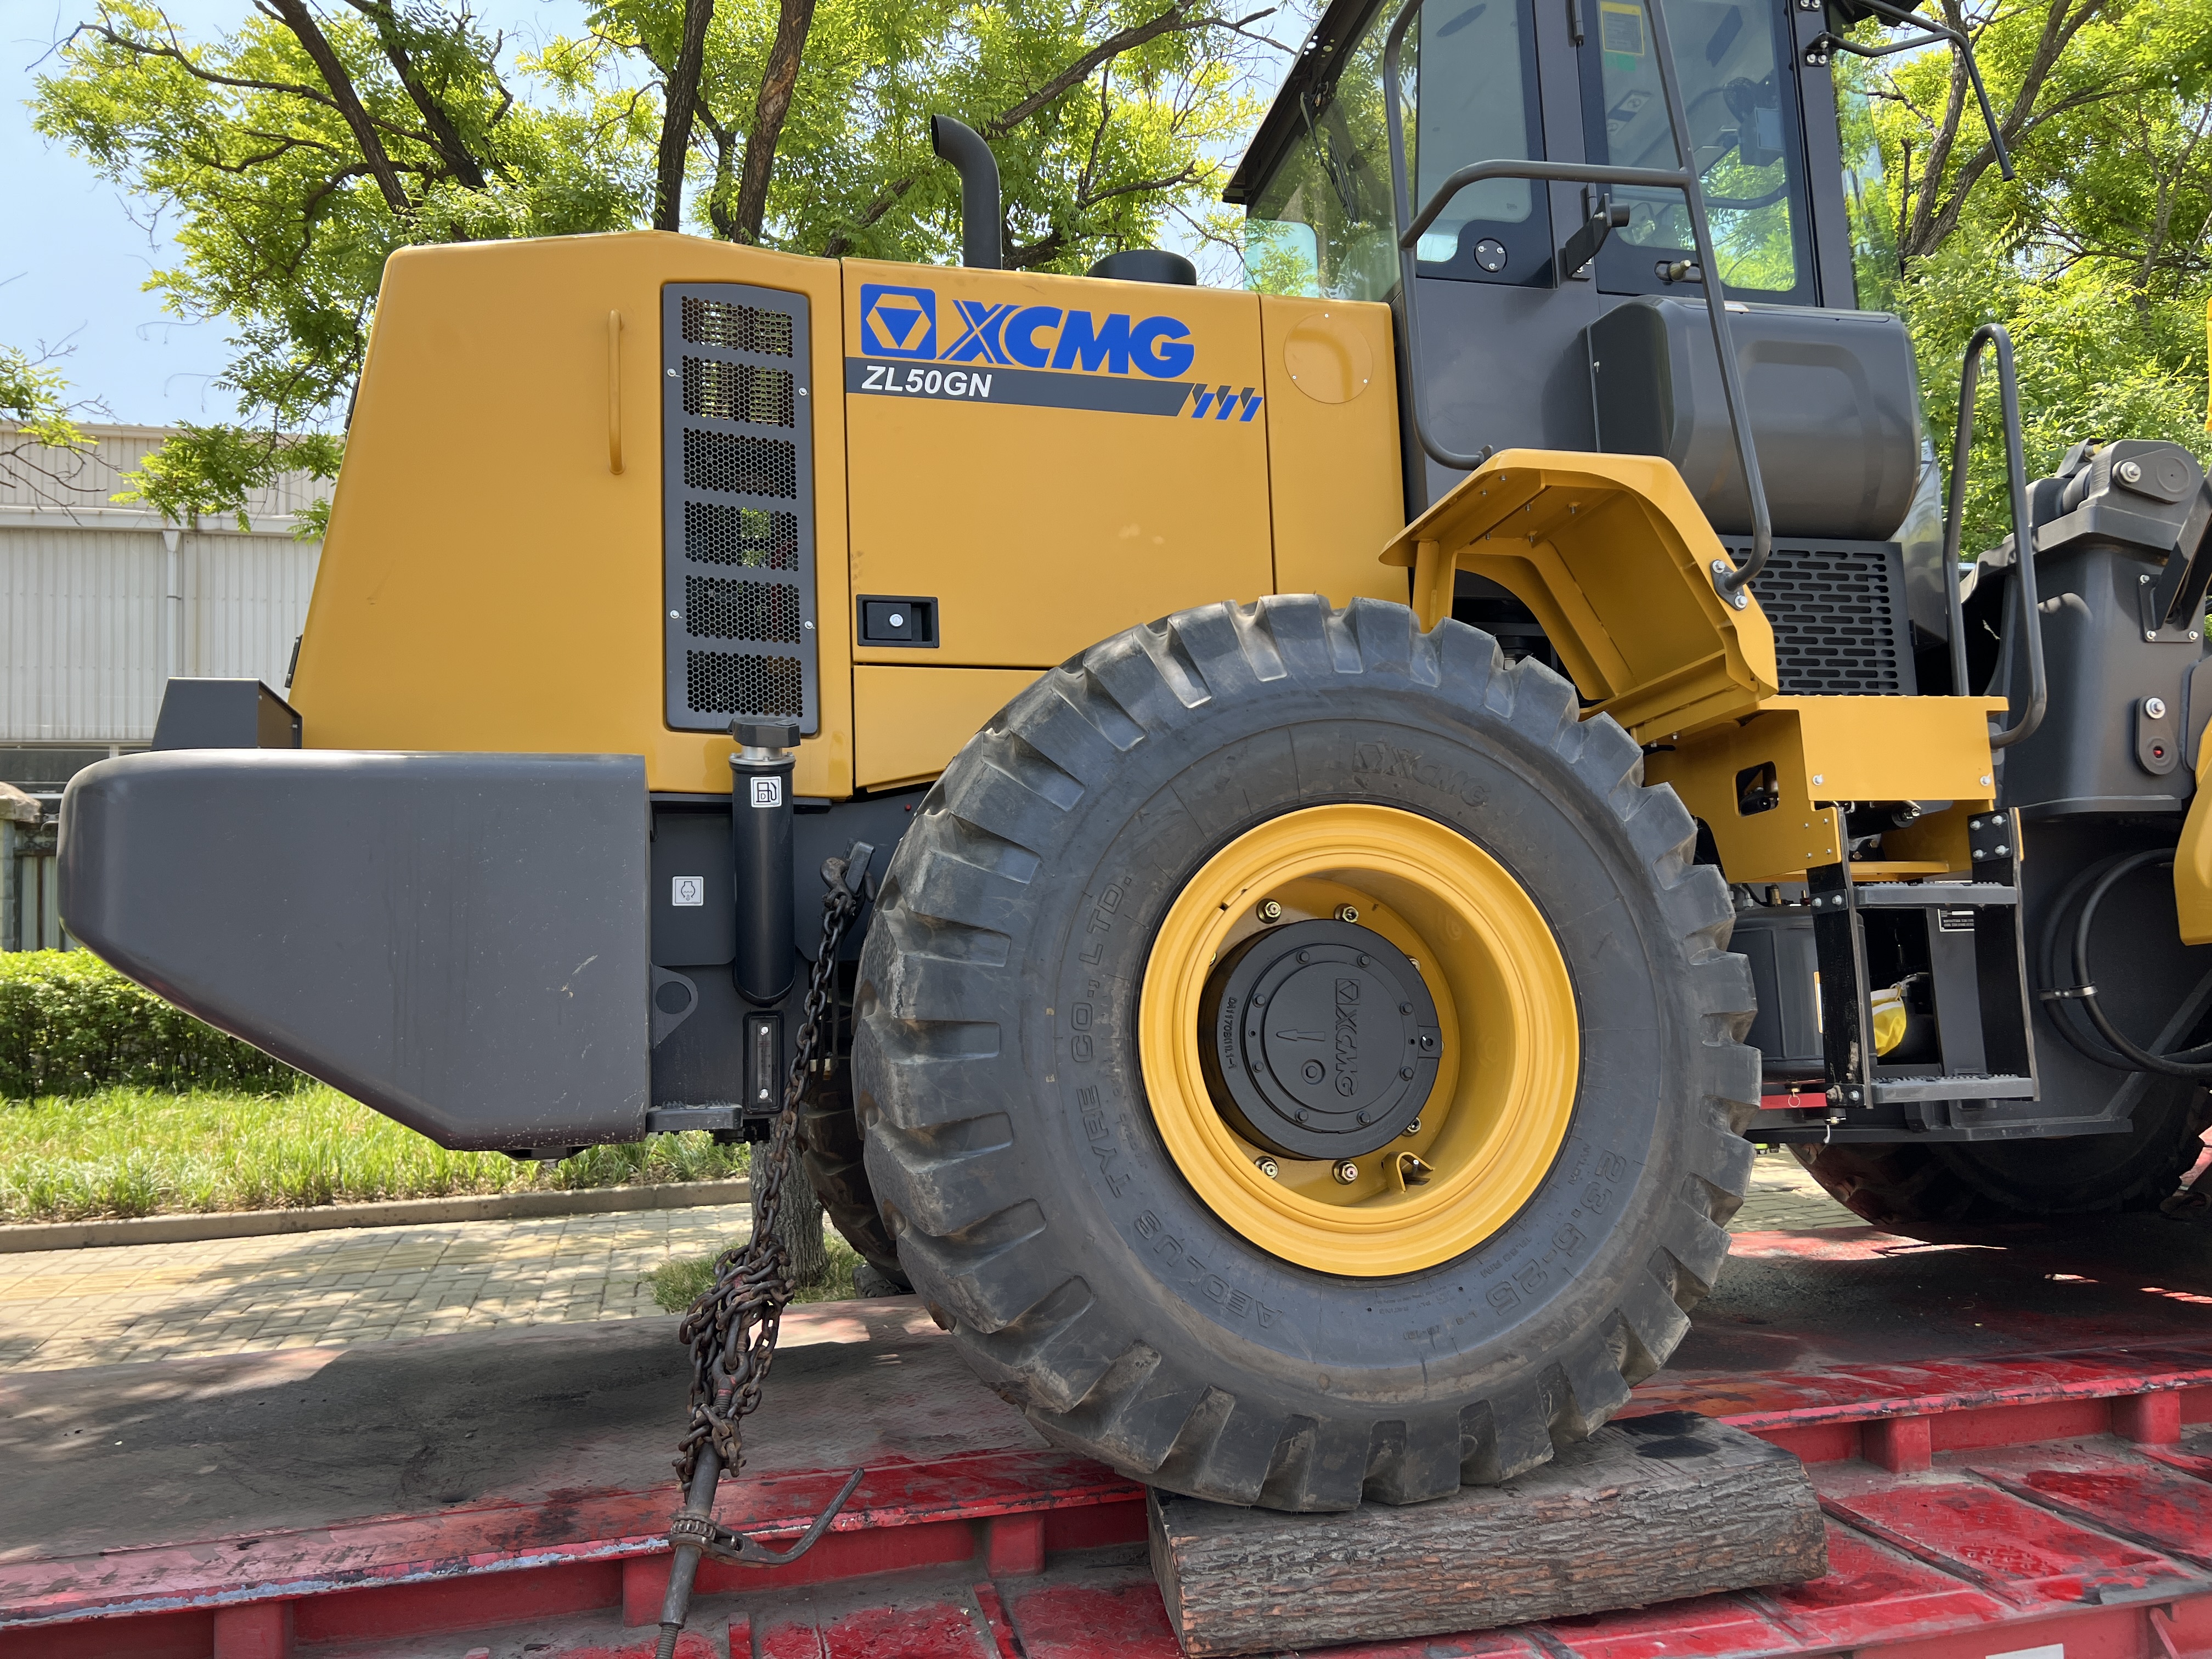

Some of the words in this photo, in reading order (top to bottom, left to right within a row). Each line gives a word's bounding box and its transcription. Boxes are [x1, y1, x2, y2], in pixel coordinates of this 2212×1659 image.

[862, 365, 992, 397] ZL50GN
[938, 300, 1194, 379] XCMG
[1385, 747, 1492, 807] XCMG
[1079, 875, 1132, 966] LTD.
[1335, 1004, 1358, 1097] XCMG
[1075, 1085, 1131, 1199] TYRE
[1567, 1143, 1593, 1186] NYLON
[1133, 1209, 1284, 1328] AEOLUS
[1480, 1260, 1502, 1278] RIM
[1486, 1148, 1627, 1317] 23.5-25
